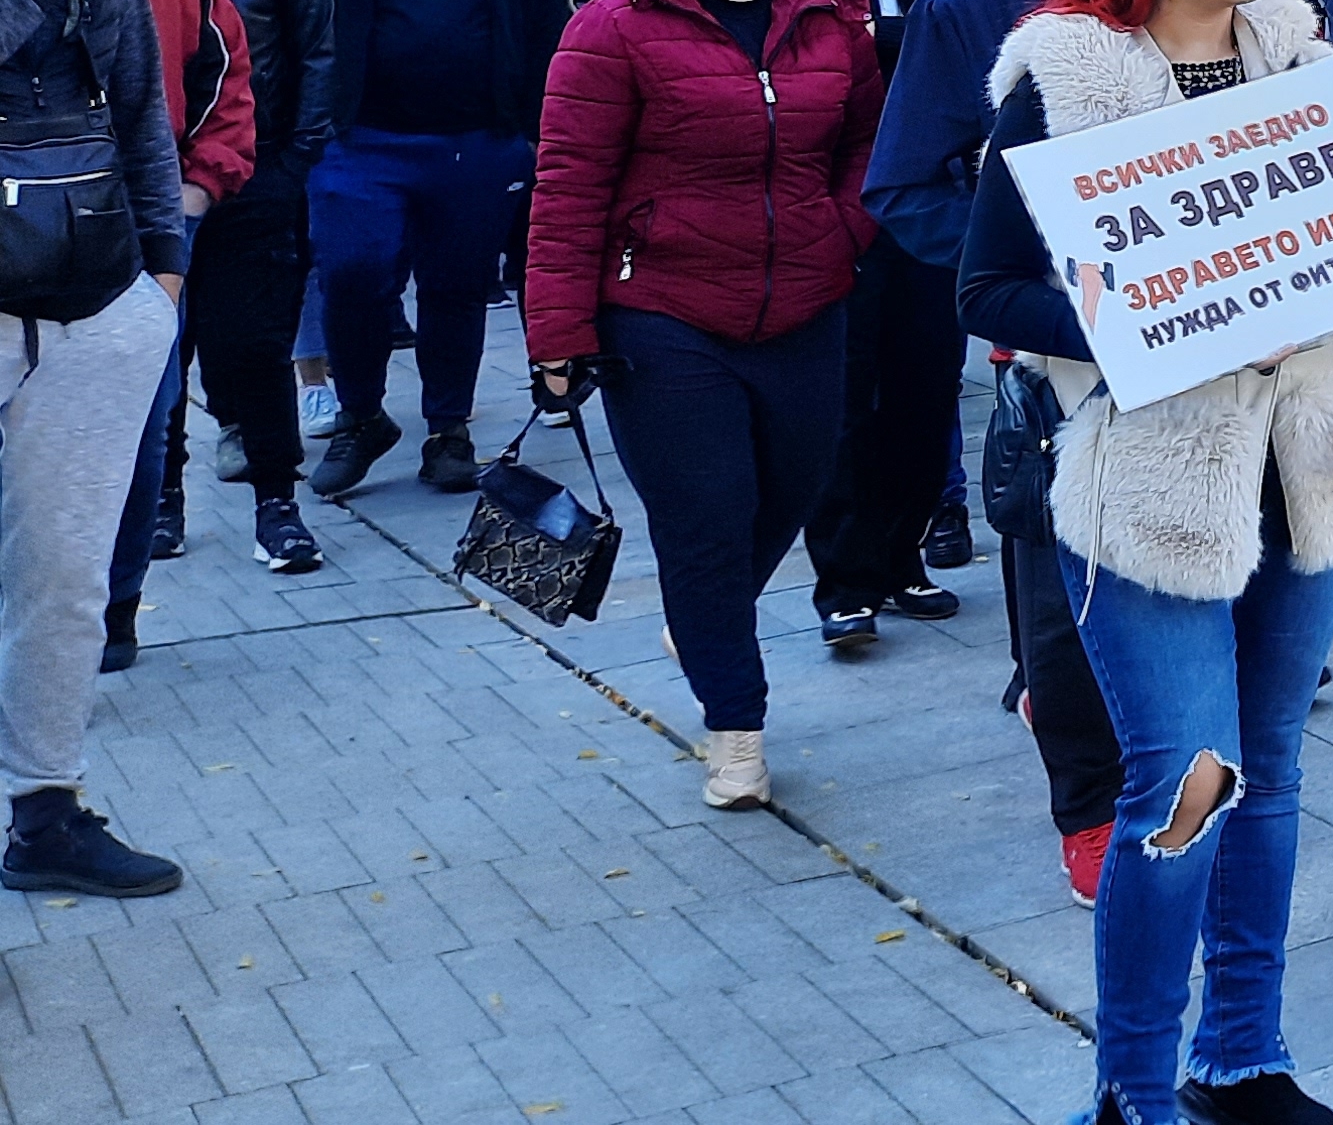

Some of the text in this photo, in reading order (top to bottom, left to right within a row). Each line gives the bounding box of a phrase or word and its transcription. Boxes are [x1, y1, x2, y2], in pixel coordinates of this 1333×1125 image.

[1073, 103, 1330, 202] ВСИЧКИ ЗАЕДНО
[1094, 204, 1166, 254] ЗА
[1121, 229, 1301, 313] ЗДРАВЕТО
[1140, 295, 1247, 351] НУЖДА
[1250, 280, 1286, 310] ОТ
